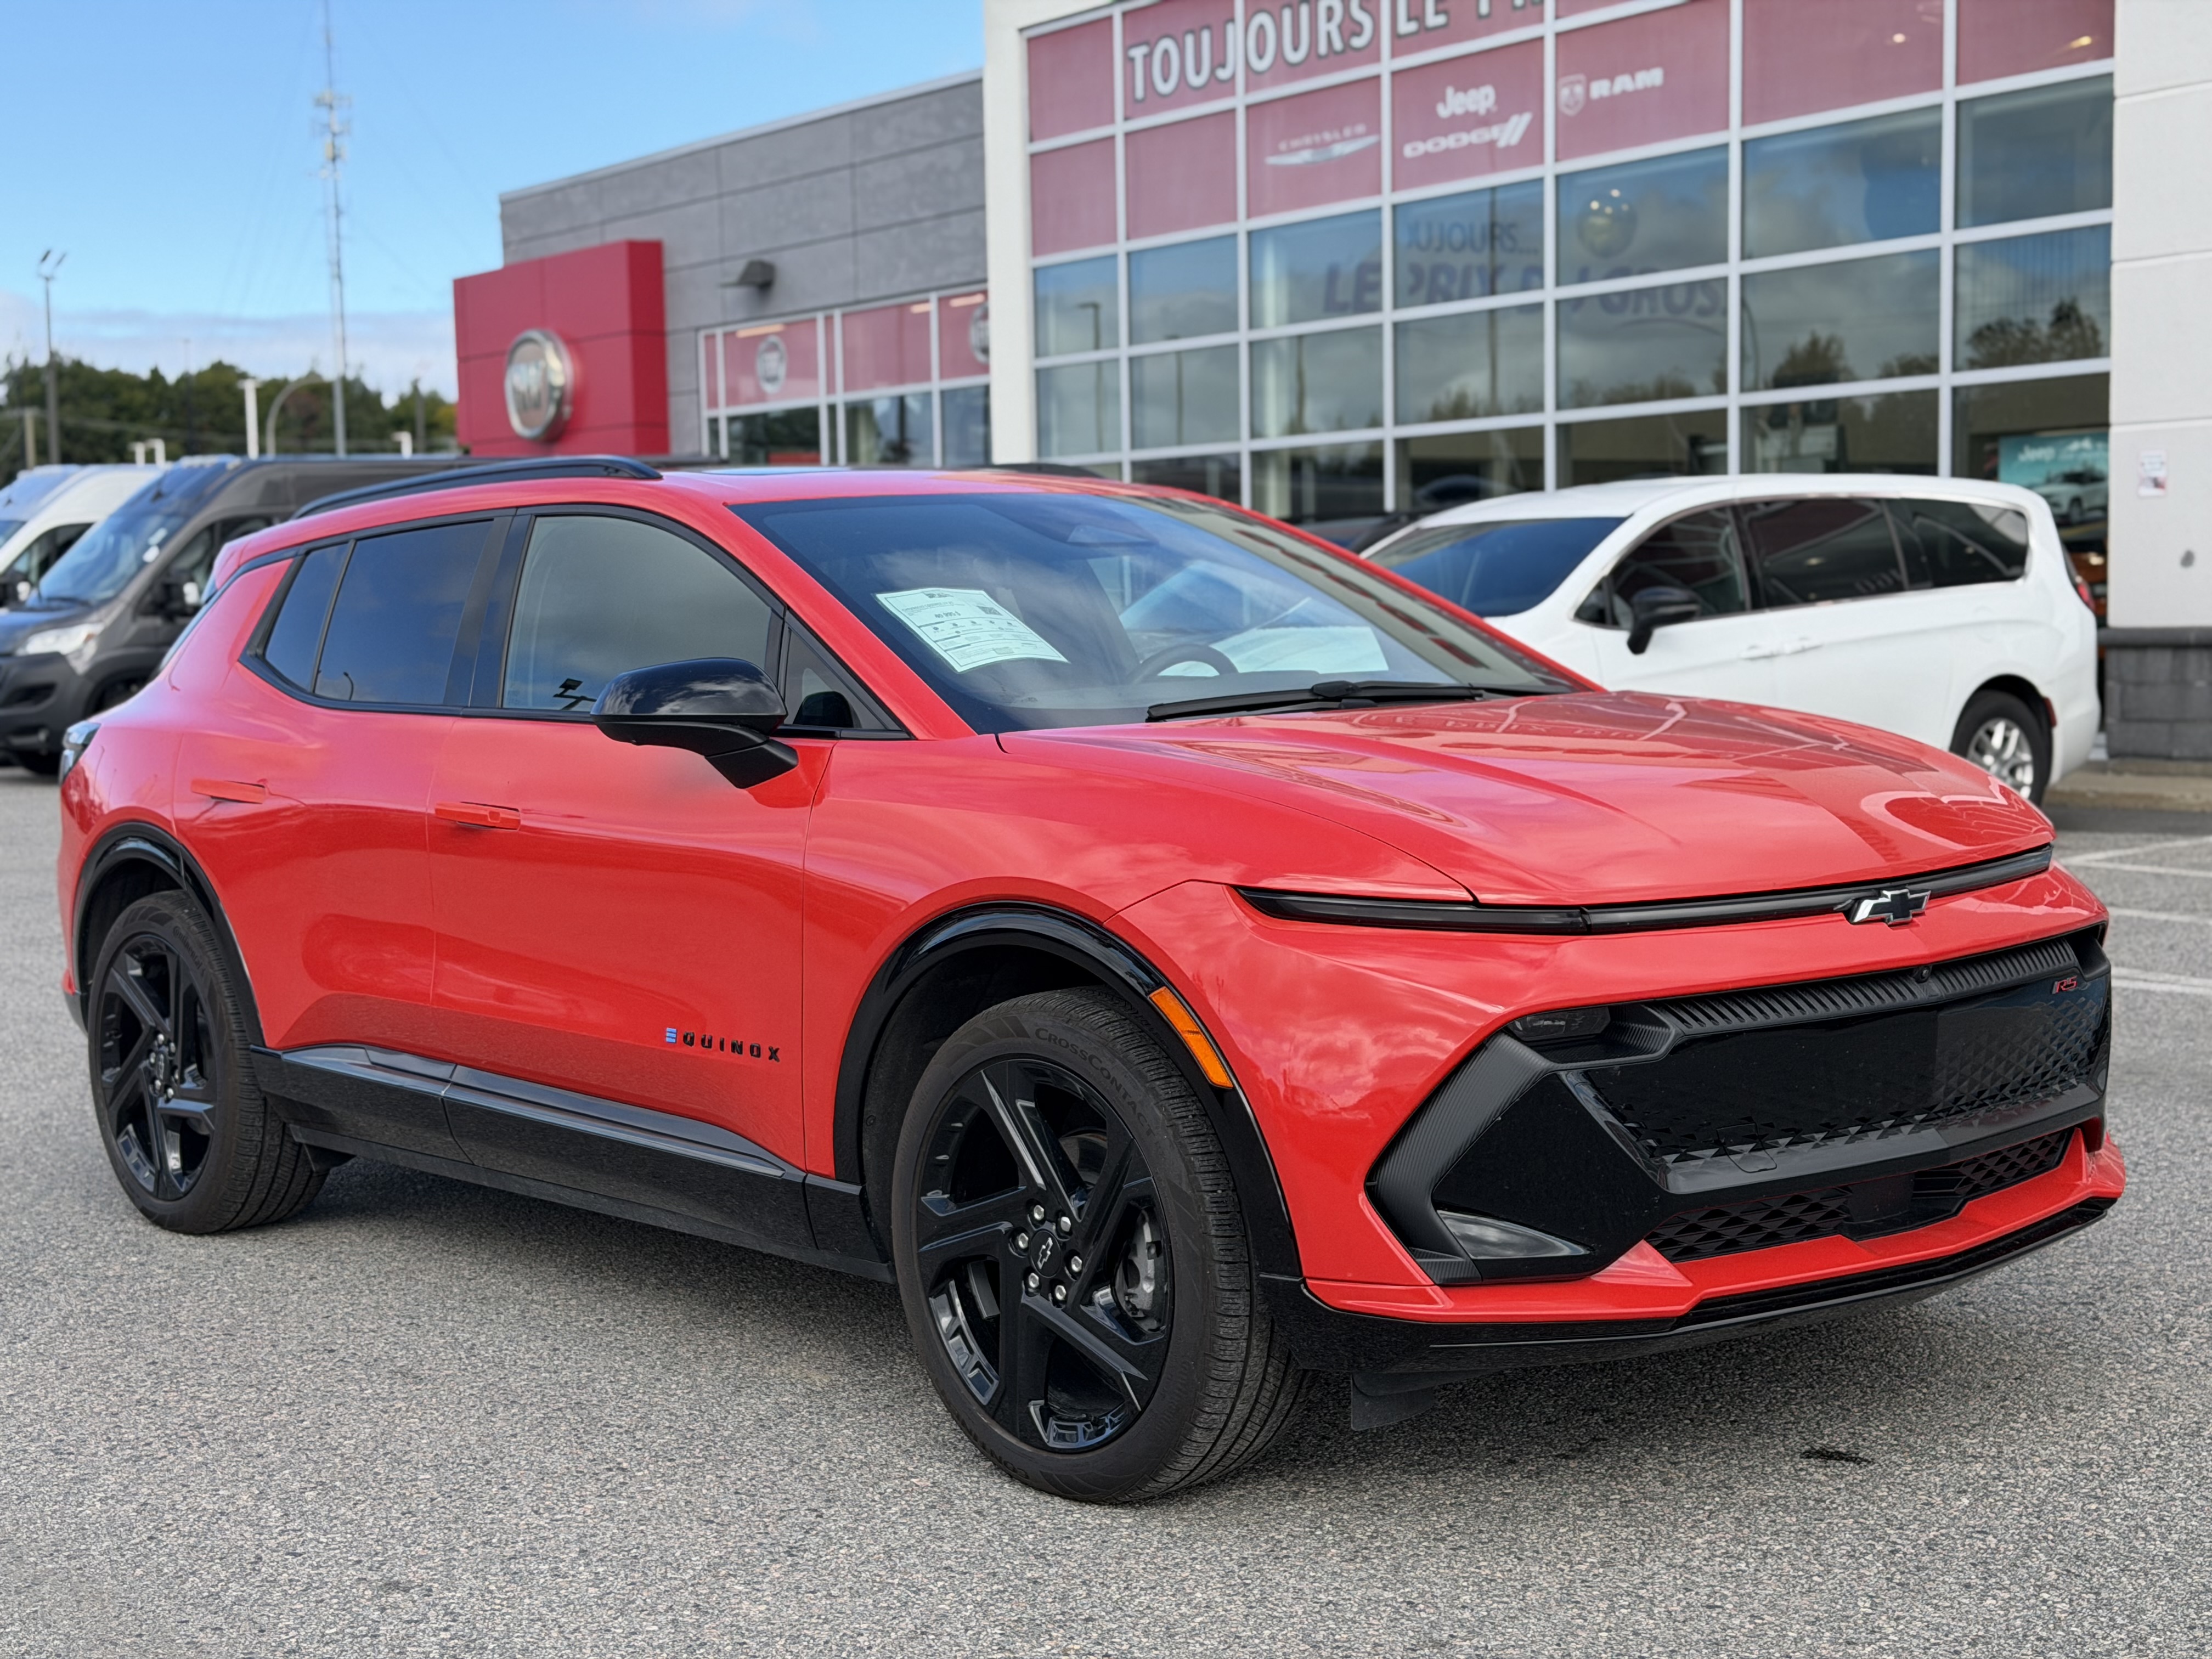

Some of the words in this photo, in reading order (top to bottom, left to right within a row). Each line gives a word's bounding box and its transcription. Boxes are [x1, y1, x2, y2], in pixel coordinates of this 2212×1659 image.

[1127, 0, 1374, 101] TOUJOURS
[1590, 66, 1663, 100] RAM
[1436, 84, 1496, 119] Jeep
[1403, 122, 1509, 159] DODGE
[2052, 975, 2078, 995] RS
[665, 1027, 781, 1063] EQUINOX
